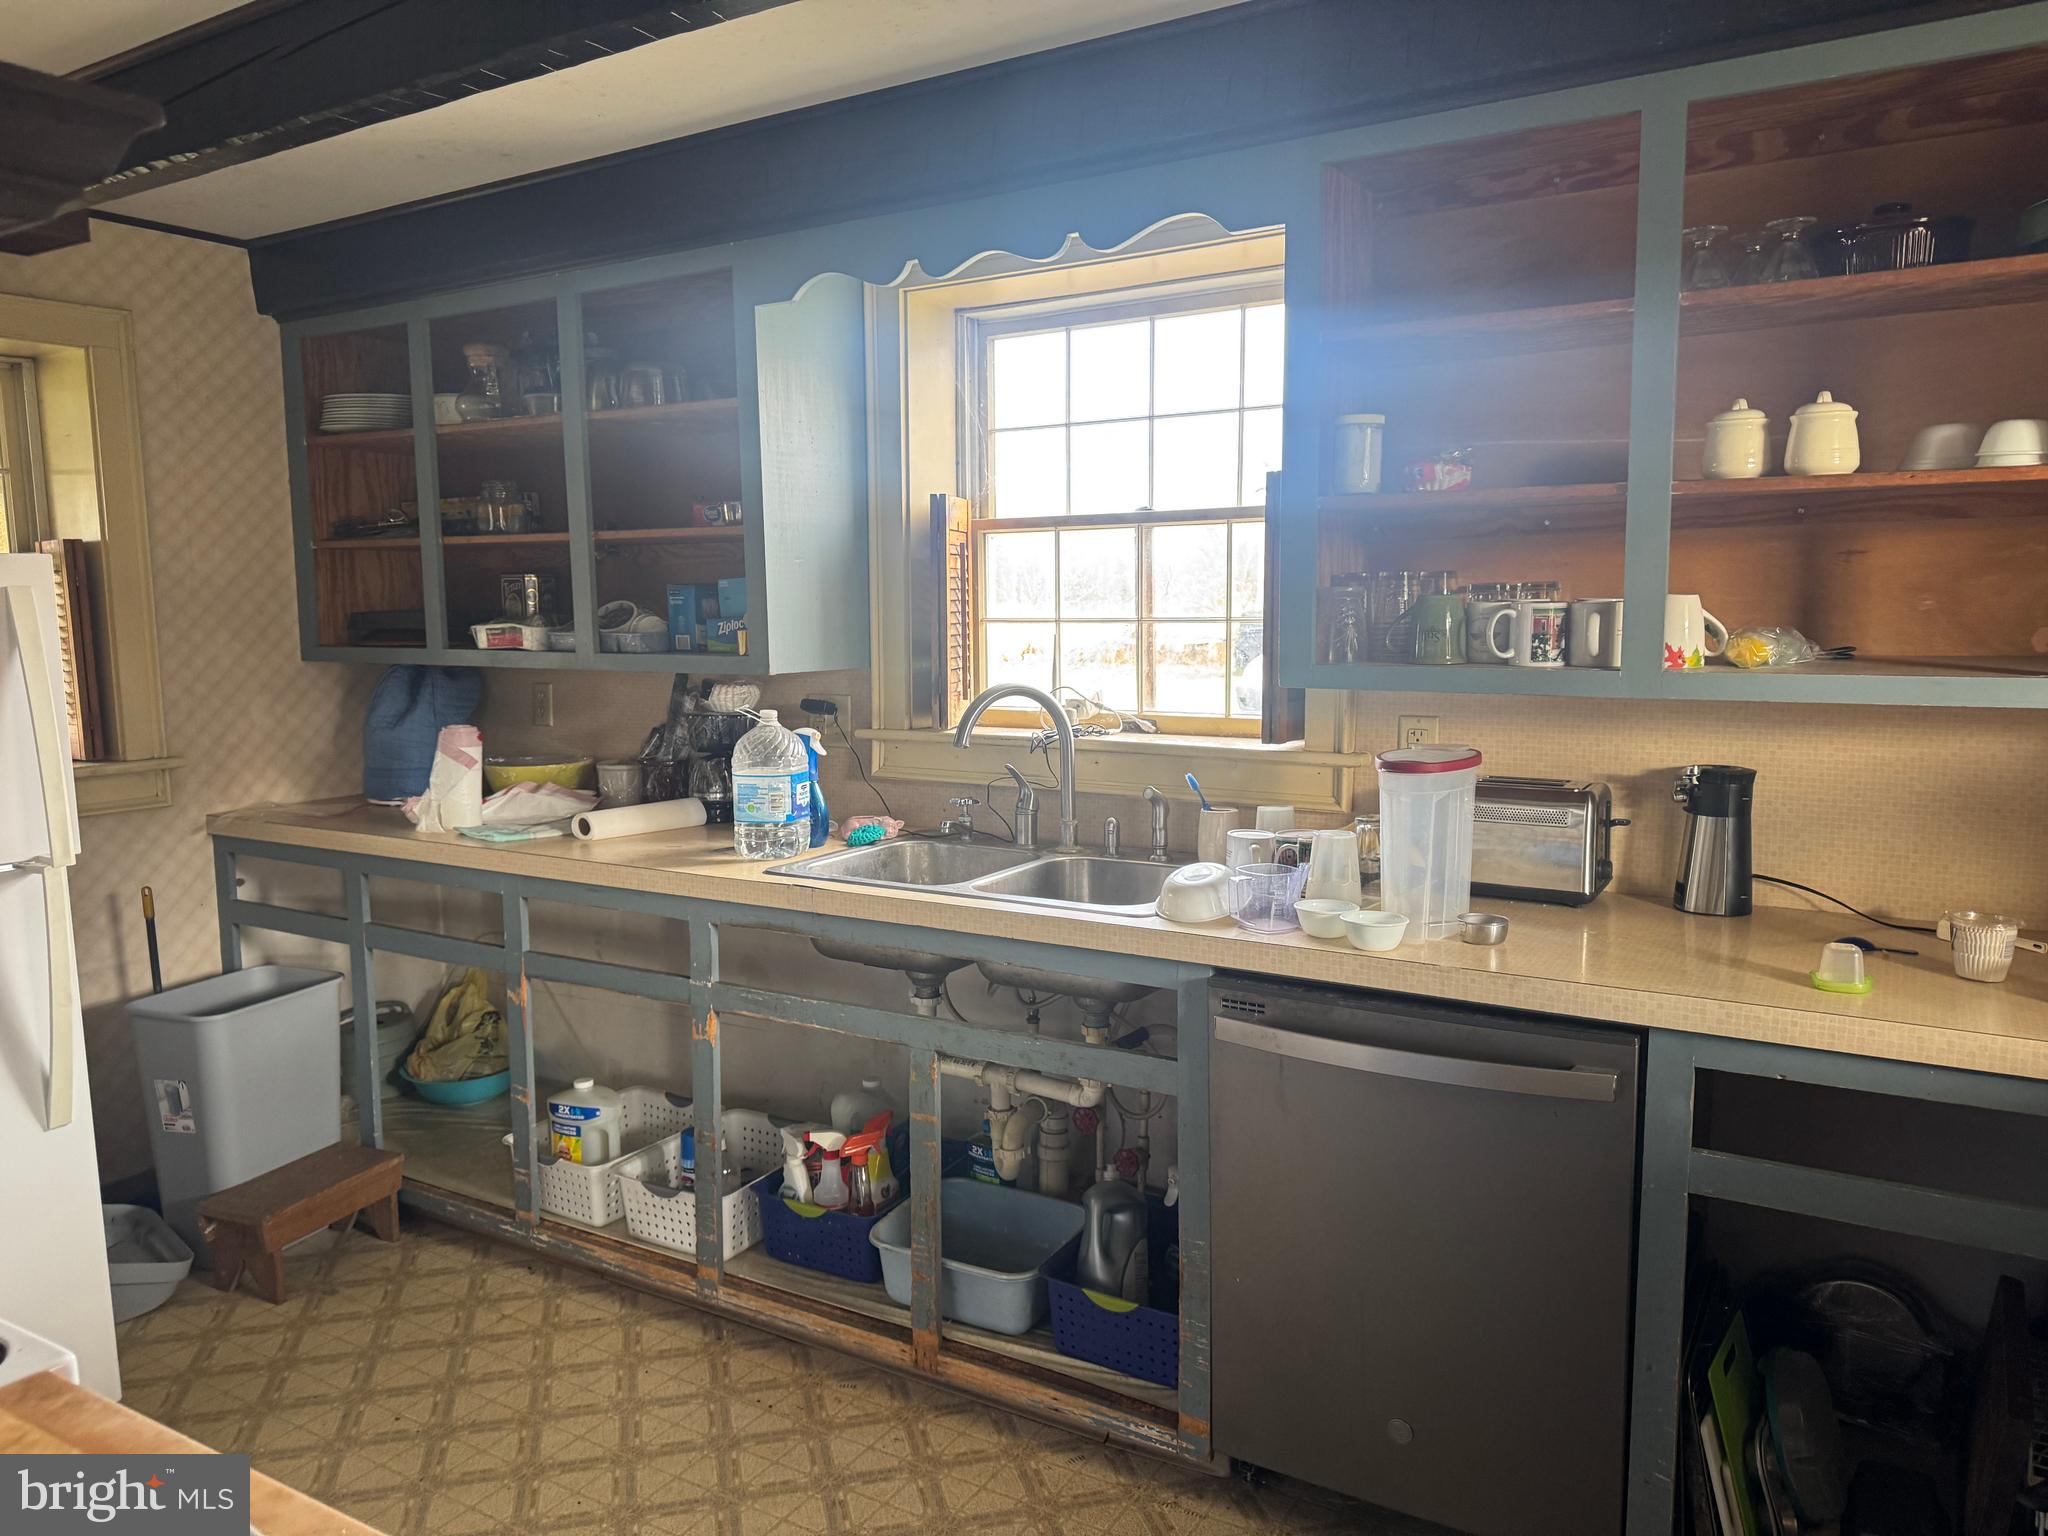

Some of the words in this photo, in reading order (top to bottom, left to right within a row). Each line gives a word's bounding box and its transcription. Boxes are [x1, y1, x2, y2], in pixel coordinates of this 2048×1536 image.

[717, 619, 745, 635] Ziploc
[558, 1105, 570, 1115] 2X
[972, 1145, 983, 1156] 2X
